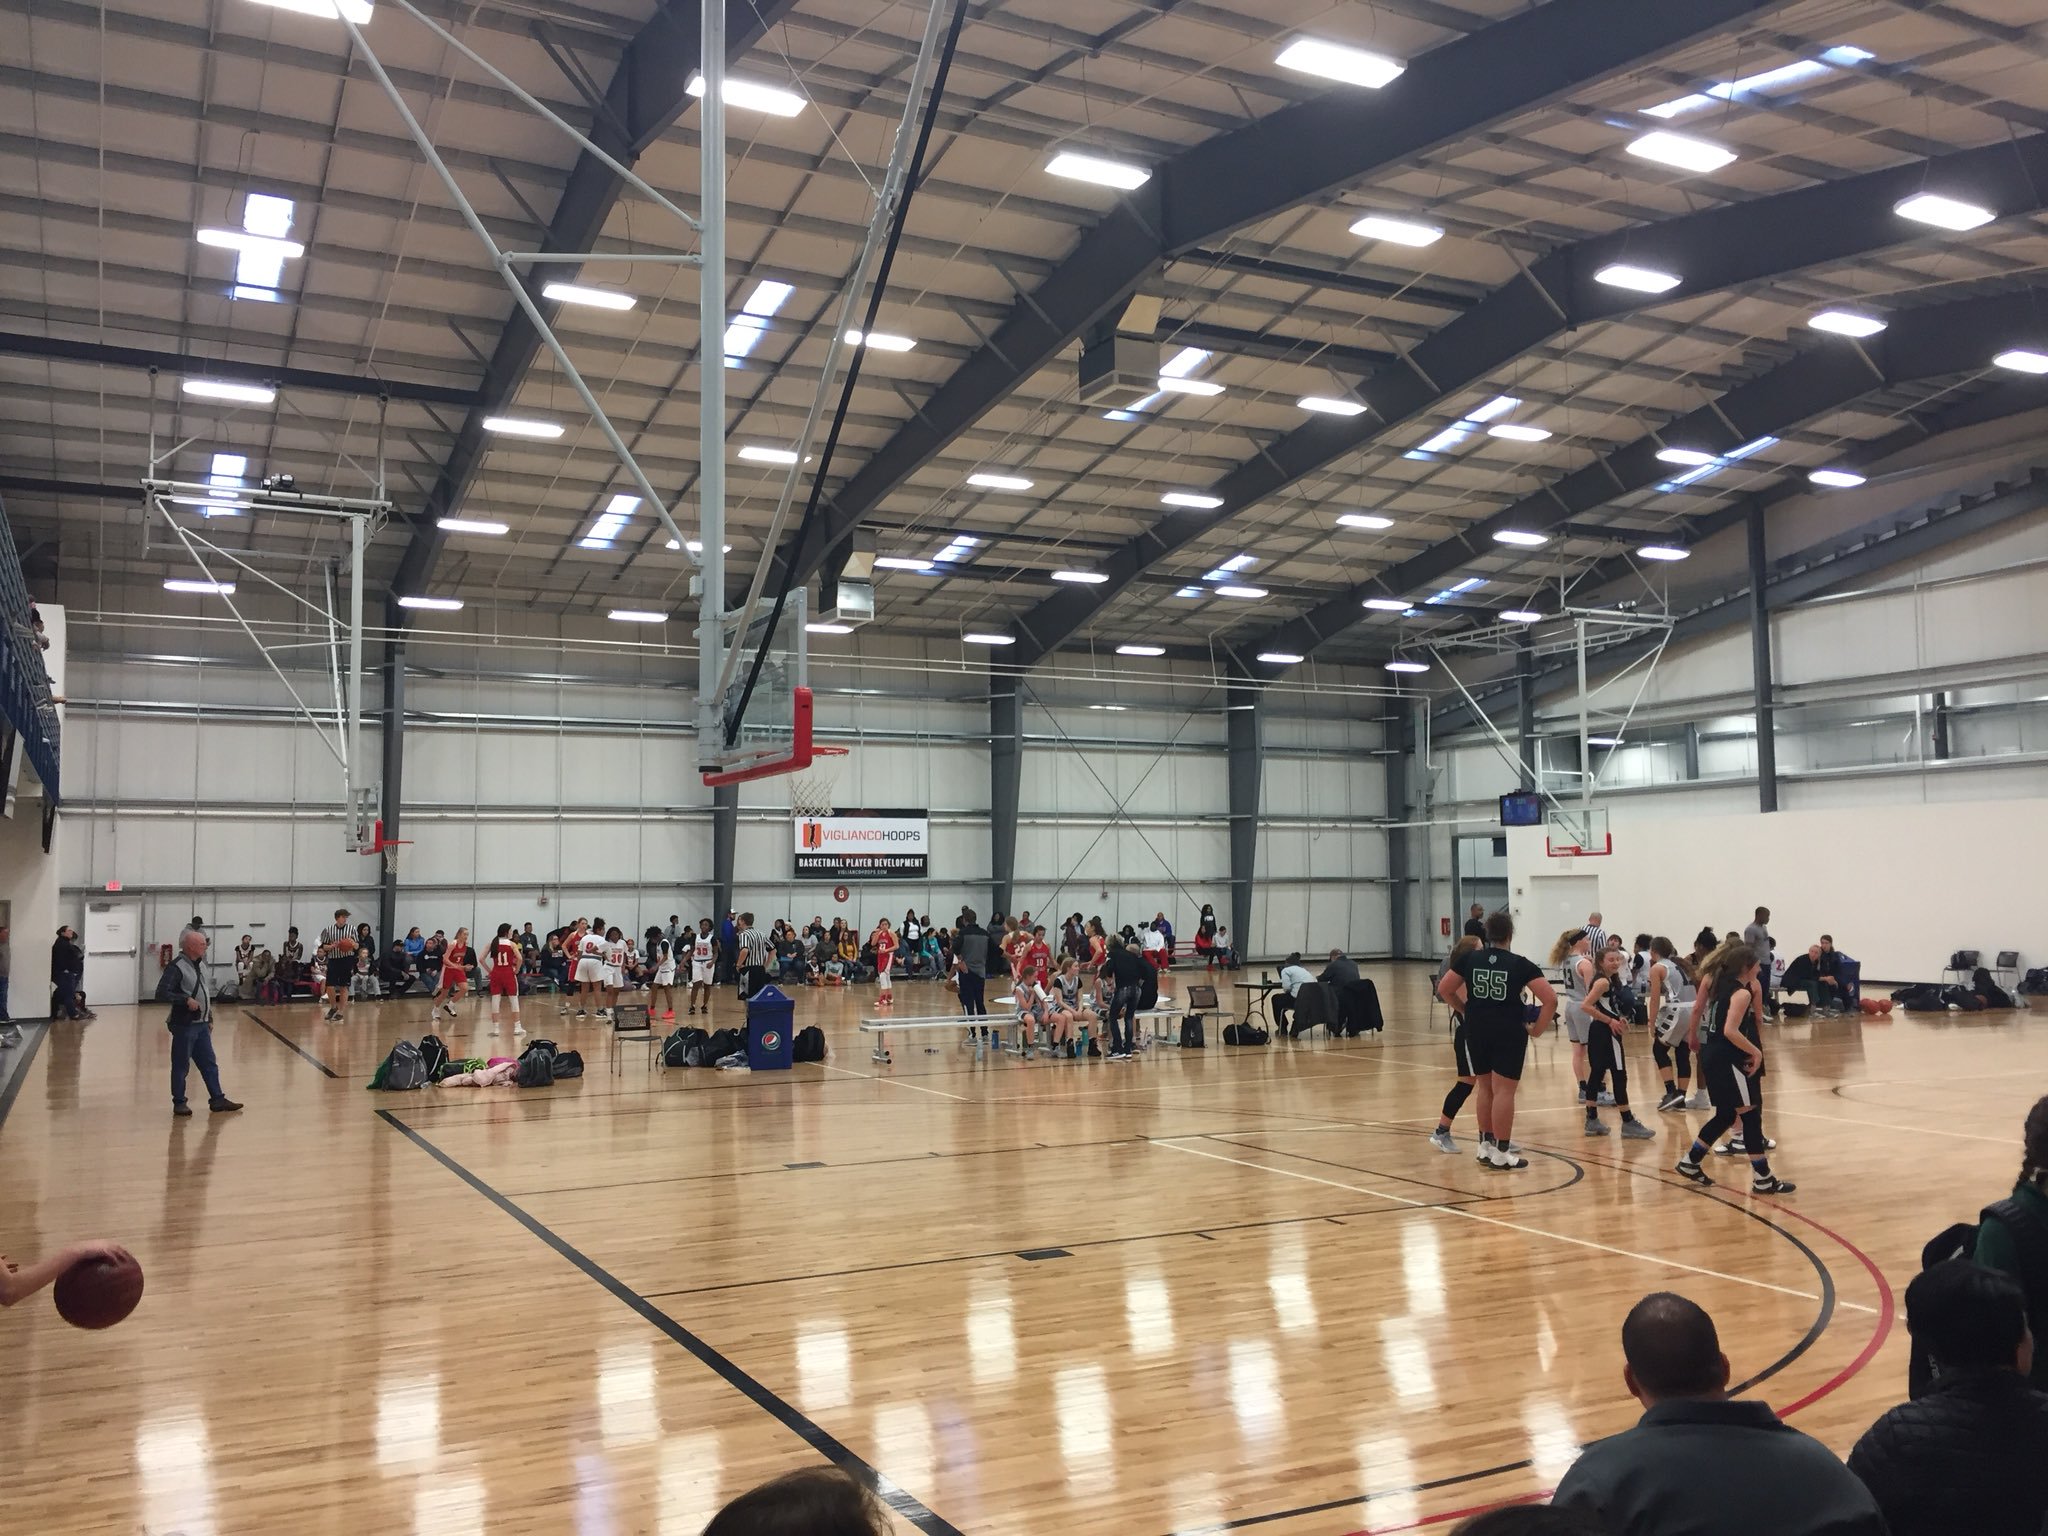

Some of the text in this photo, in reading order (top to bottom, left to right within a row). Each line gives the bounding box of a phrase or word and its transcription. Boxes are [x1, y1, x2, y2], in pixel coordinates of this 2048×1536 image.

[822, 830, 921, 841] VIGLIANCOHOOPS
[799, 858, 923, 868] BASKETBALL PLAYER DEVELOPMENT
[838, 889, 845, 899] 8
[497, 951, 509, 966] 11
[1036, 959, 1044, 967] 10
[1563, 967, 1575, 990] 13
[1472, 968, 1508, 1001] 55
